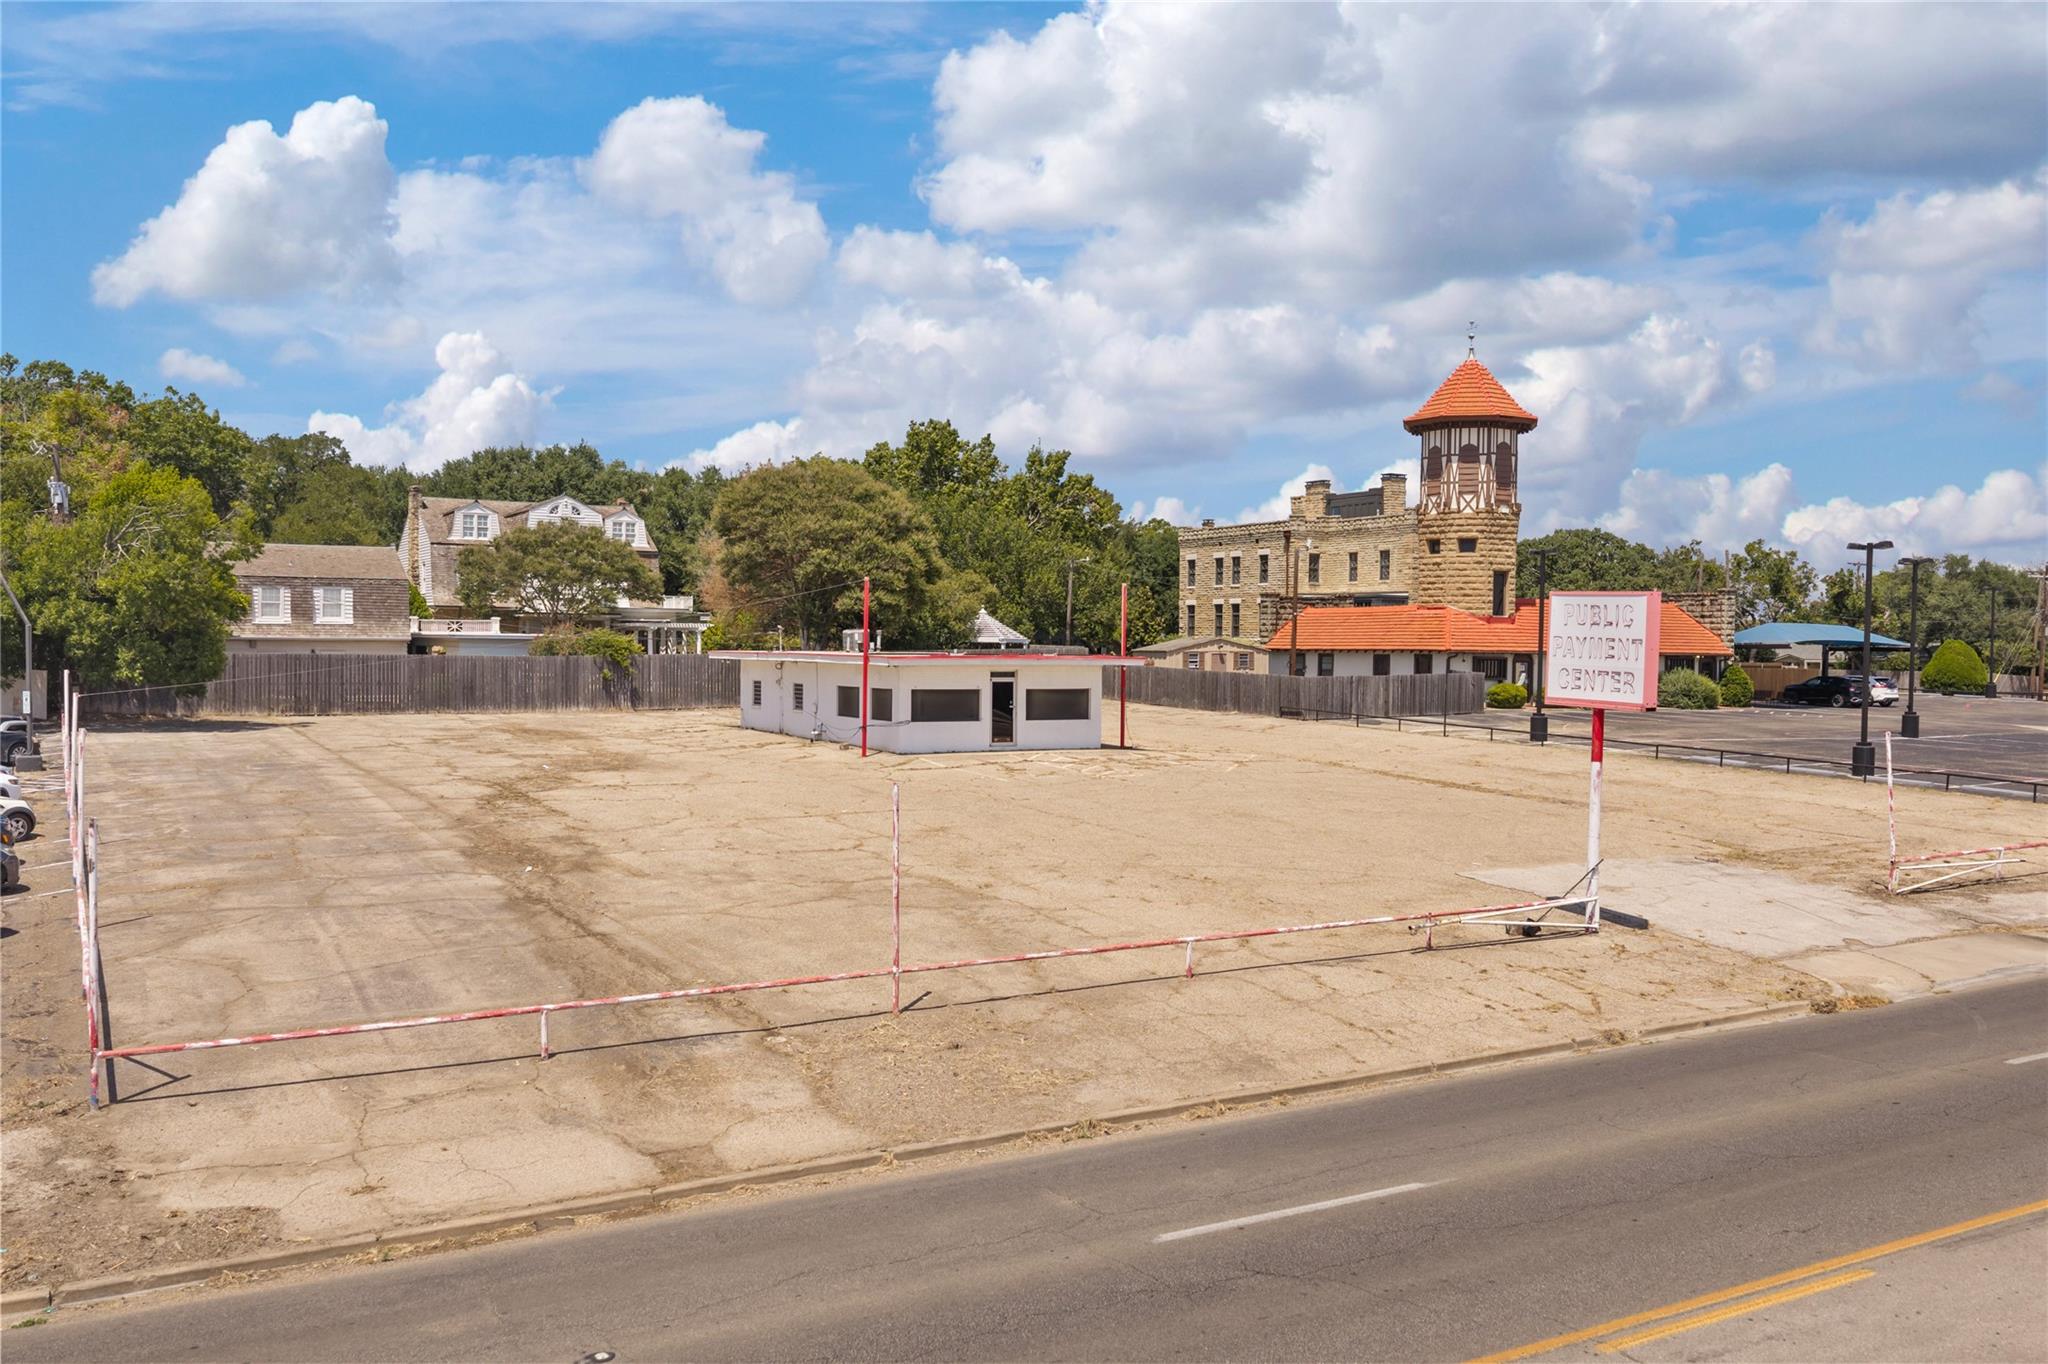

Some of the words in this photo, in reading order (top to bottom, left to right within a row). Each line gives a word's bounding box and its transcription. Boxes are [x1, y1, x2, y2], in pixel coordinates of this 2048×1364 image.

[1564, 603, 1634, 628] PUBLIC
[1552, 636, 1643, 662] PAYMENT
[1559, 667, 1636, 694] CENTER
